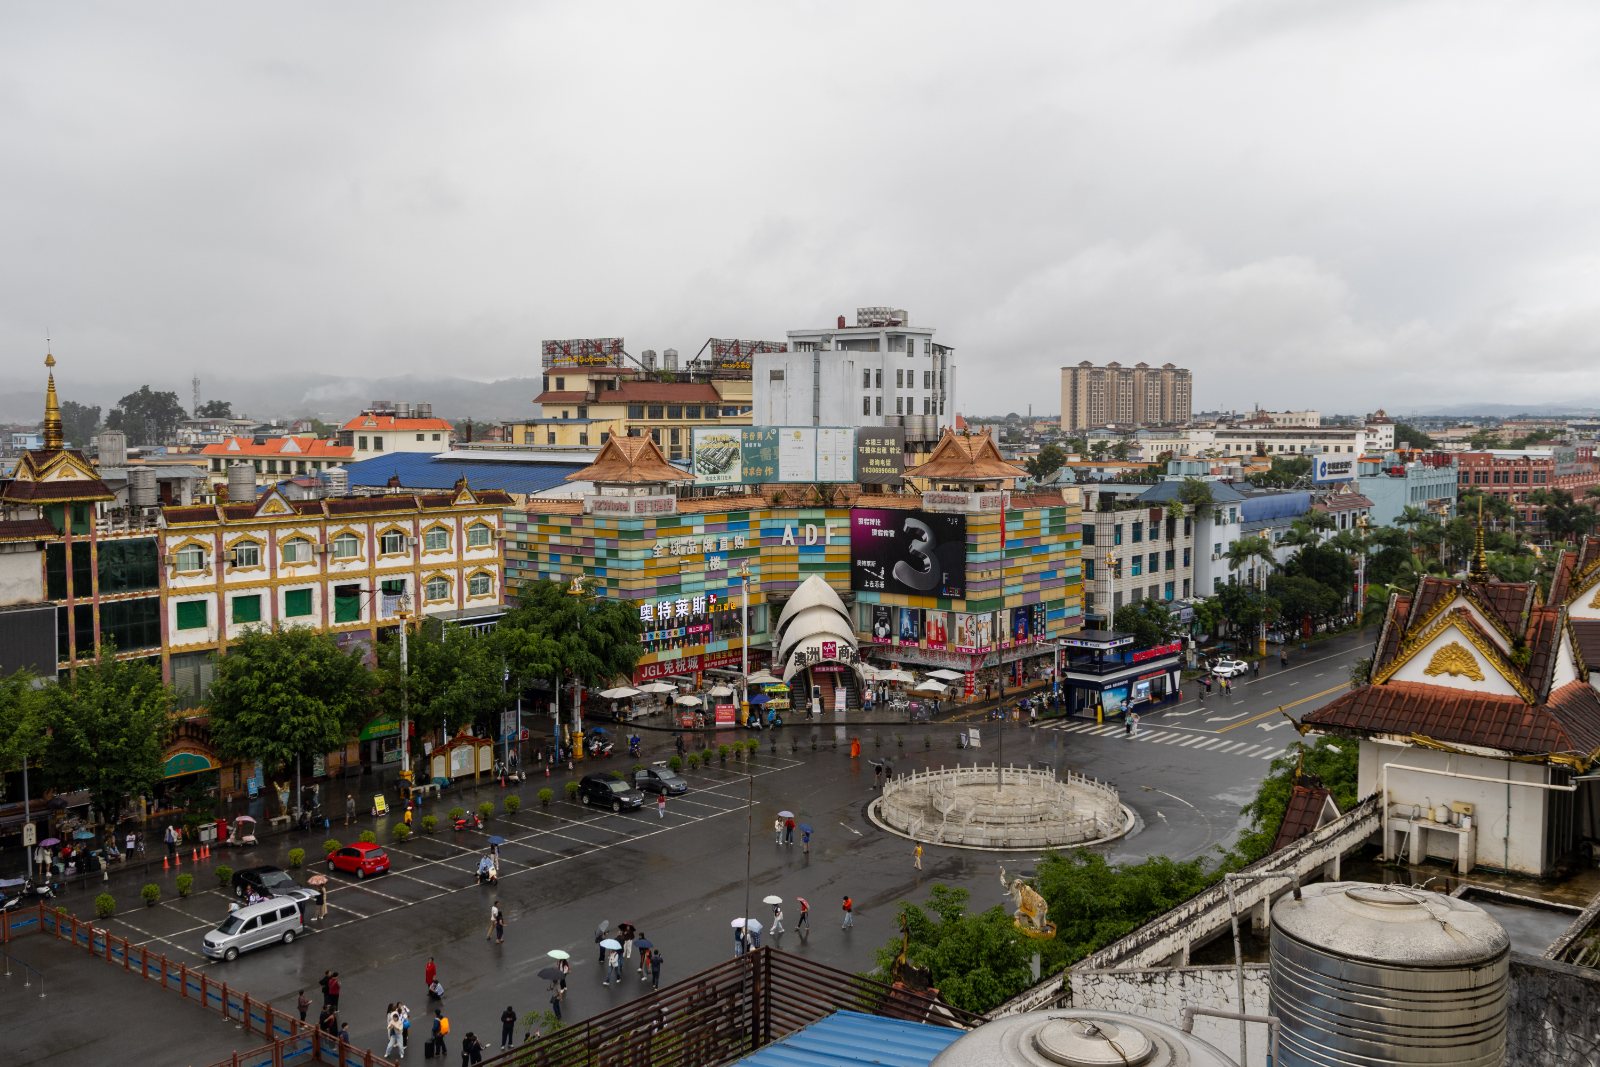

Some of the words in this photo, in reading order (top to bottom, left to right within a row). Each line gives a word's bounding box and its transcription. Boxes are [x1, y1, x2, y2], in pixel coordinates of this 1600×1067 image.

[782, 523, 838, 546] ADF
[652, 535, 745, 558] 全球品牌直购
[640, 596, 706, 623] 奥特莱斯
[642, 655, 699, 678] JGL免税城
